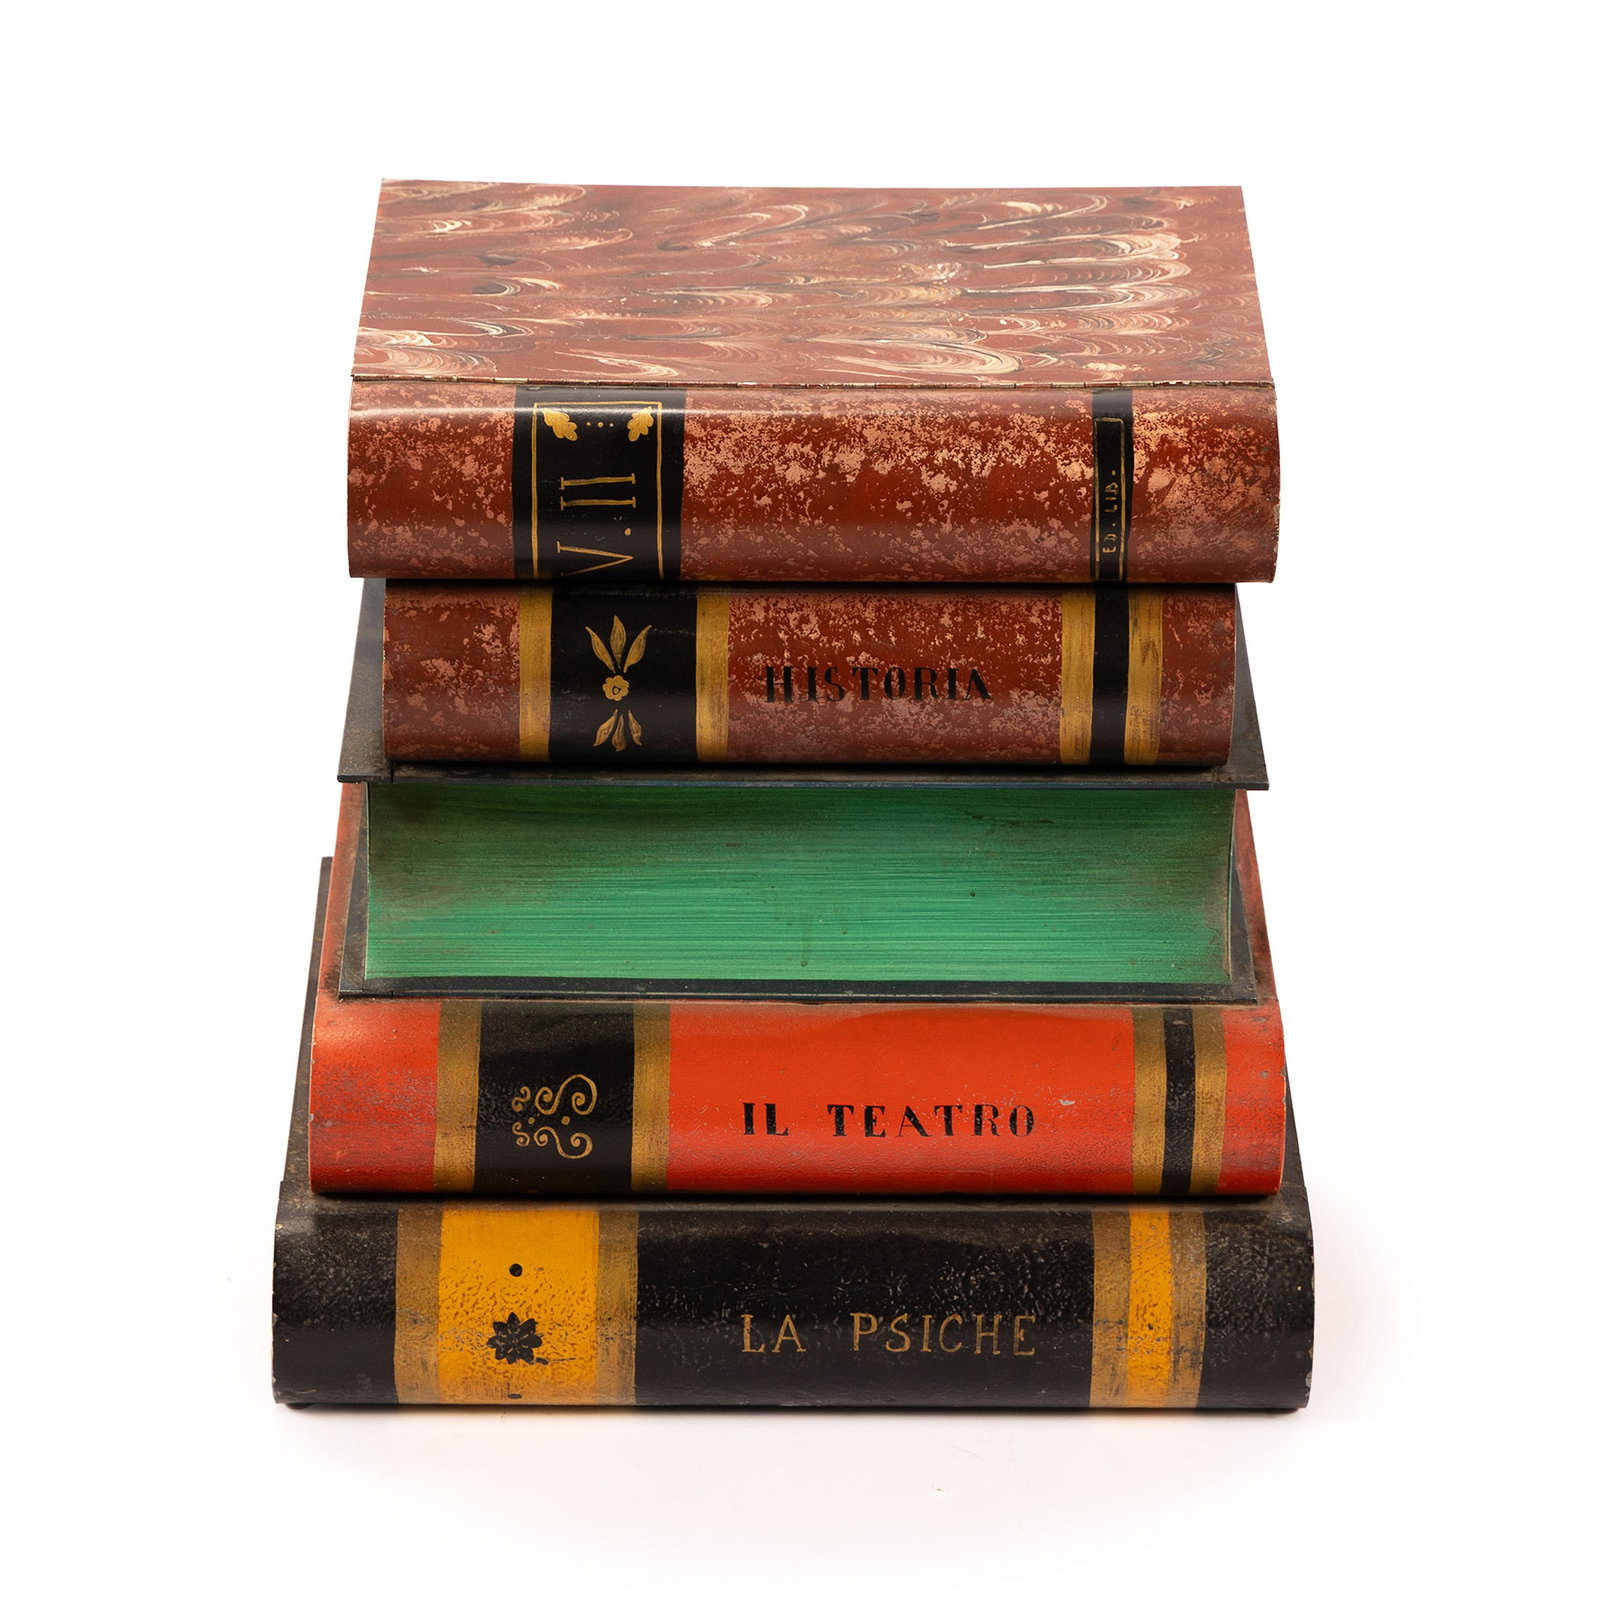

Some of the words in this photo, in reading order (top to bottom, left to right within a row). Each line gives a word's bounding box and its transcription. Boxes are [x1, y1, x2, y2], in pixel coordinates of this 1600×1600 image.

[765, 666, 993, 702] HISTORIA
[742, 1102, 789, 1136] IL
[827, 1104, 1035, 1138] TEATRO
[740, 1314, 806, 1352] LA
[850, 1312, 1036, 1356] PSICHE
